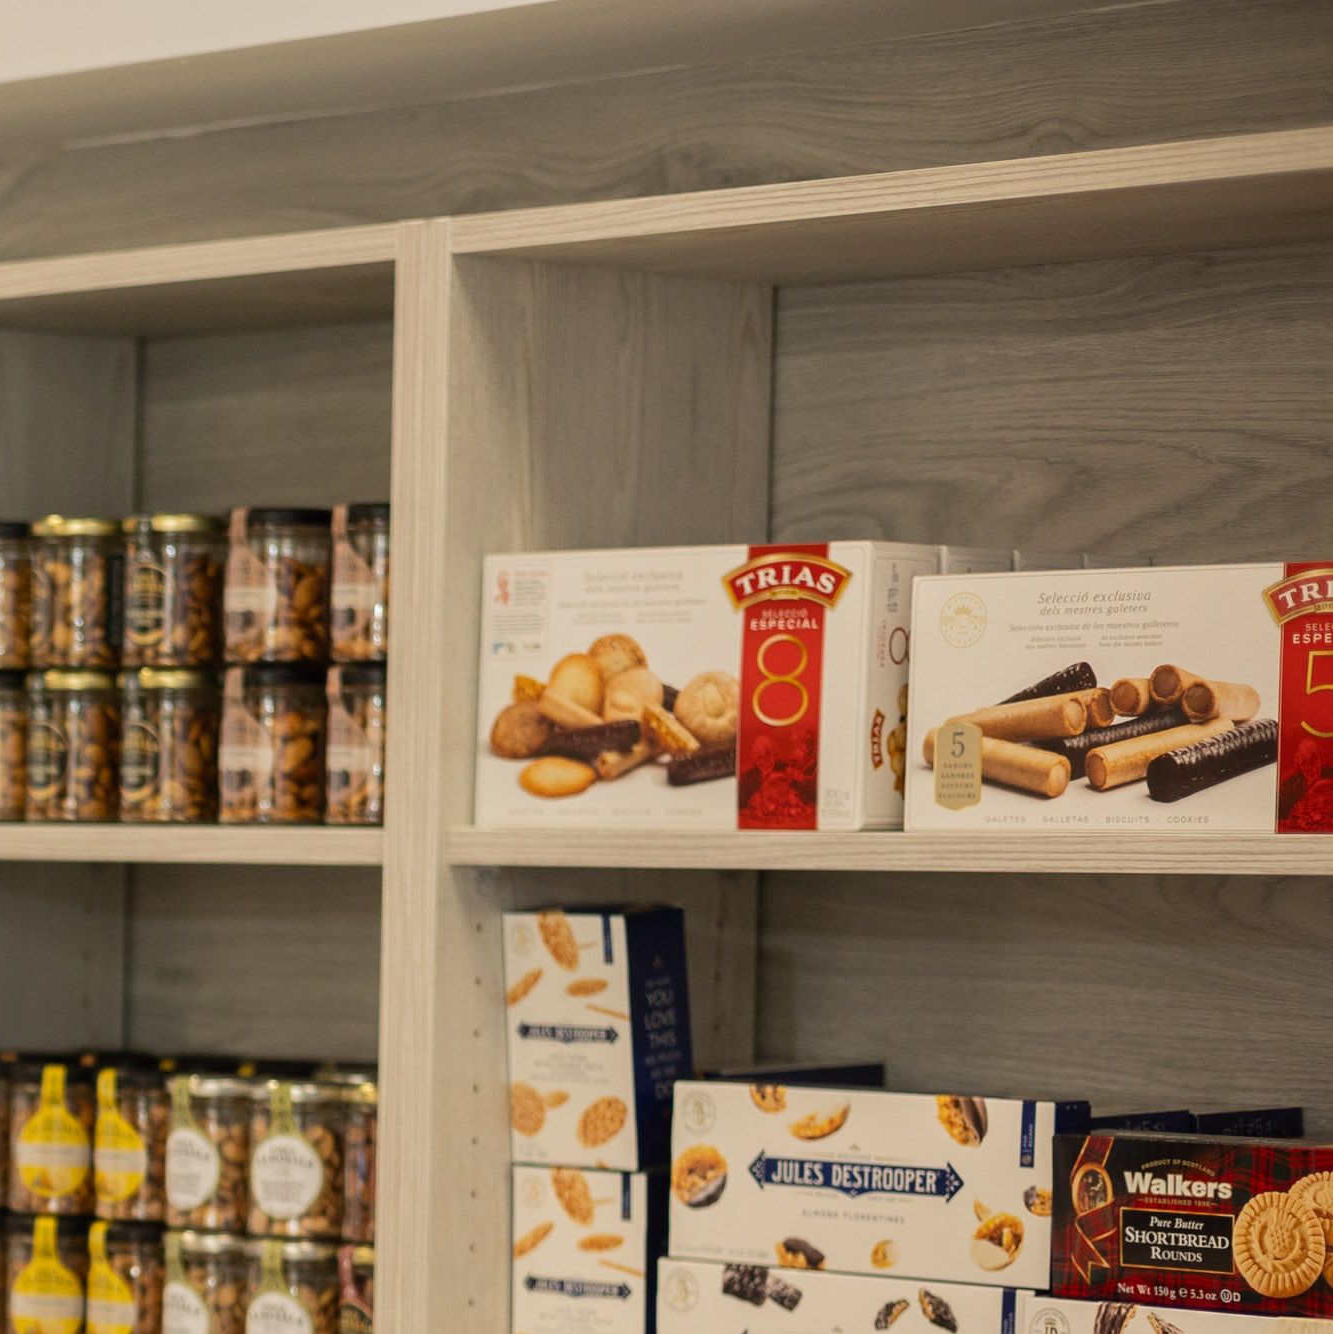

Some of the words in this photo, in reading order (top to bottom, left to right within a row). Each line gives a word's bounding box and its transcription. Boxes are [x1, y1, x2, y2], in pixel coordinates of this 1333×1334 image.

[735, 564, 836, 596] TRIAS
[1037, 591, 1088, 604] Selecció
[1093, 590, 1152, 603] exclusiva
[1278, 580, 1333, 609] TRI
[1039, 605, 1061, 616] dels
[1064, 606, 1103, 615] mestres
[1106, 604, 1149, 616] galeters
[749, 618, 819, 631] ESPECIAL
[1305, 623, 1333, 632] SELE
[1292, 633, 1333, 644] ESPE
[752, 633, 809, 727] 8
[951, 731, 965, 758] 5
[1041, 815, 1090, 824] GALLETAS
[1105, 815, 1151, 824] BISCUITS
[1166, 815, 1210, 824] COOKIES
[771, 1160, 824, 1186] JULES
[831, 1163, 937, 1194] DESTROOPER
[1141, 1159, 1170, 1170] PRODUCT
[1182, 1159, 1215, 1177] SCOTLAND
[1124, 1171, 1232, 1199] Walkers
[1149, 1216, 1172, 1228] Pure
[1174, 1218, 1205, 1230] Butter
[1125, 1226, 1229, 1249] SHORTBREAD
[1151, 1247, 1203, 1262] ROUNDS
[1117, 1282, 1134, 1294] Net
[1137, 1284, 1151, 1296] Wt
[1190, 1289, 1204, 1300] 5.3
[1205, 1292, 1217, 1301] oz
